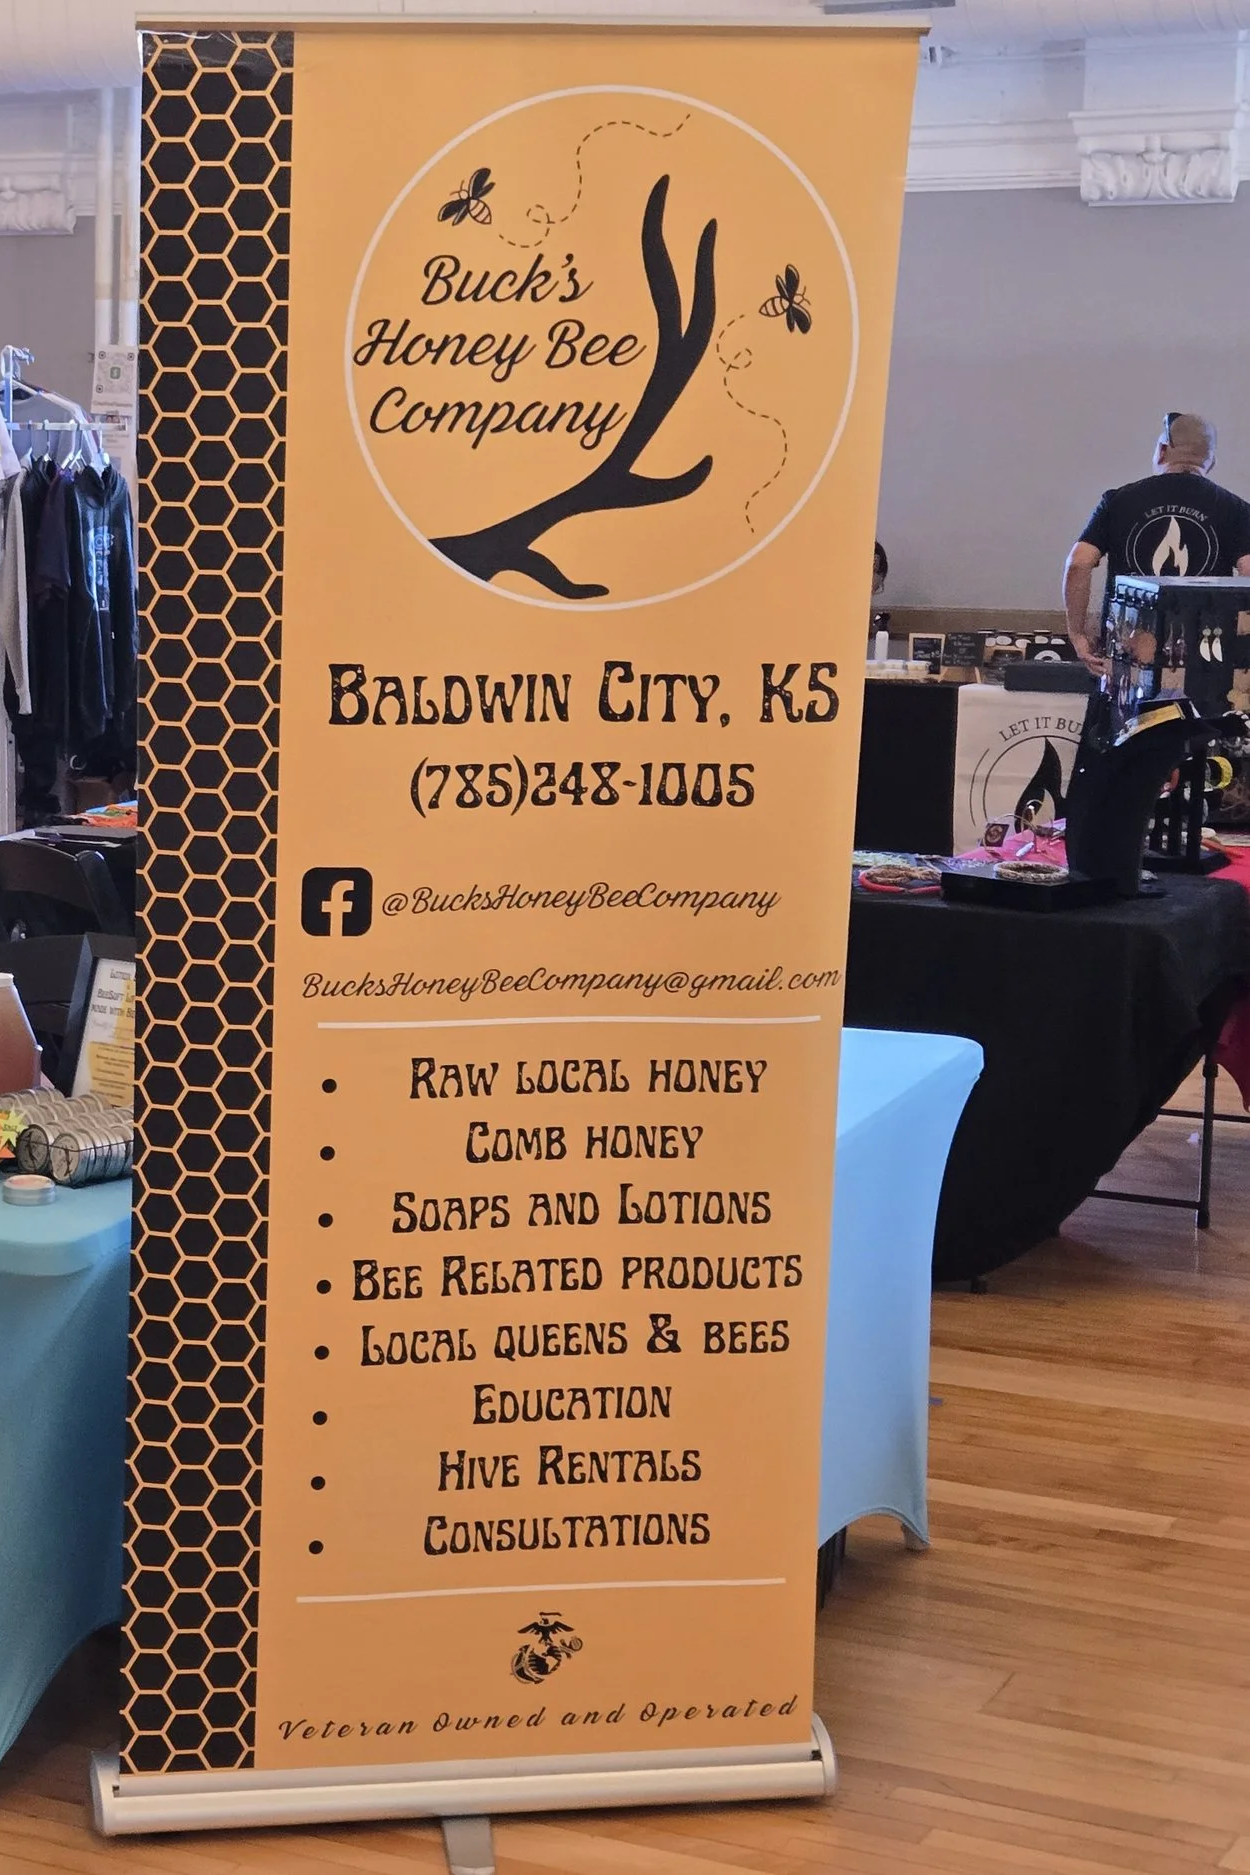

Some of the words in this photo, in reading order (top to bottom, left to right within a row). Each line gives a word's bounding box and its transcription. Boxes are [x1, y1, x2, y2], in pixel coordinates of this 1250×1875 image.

[421, 253, 594, 305] Buck's
[353, 319, 537, 383] Honey
[545, 319, 647, 369] Bee
[370, 386, 628, 450] Company
[1144, 506, 1164, 519] LET
[1179, 506, 1209, 522] BURN
[329, 664, 571, 725] BALDWIN
[759, 662, 839, 723] KS
[999, 719, 1030, 742] LET
[1035, 716, 1051, 729] IT
[411, 755, 754, 818] (785)248-1005
[382, 882, 782, 918] @BucksHoneyBeeCompany
[303, 966, 841, 1003] BucksHoneyBeeCompany@gmail.com
[647, 1313, 681, 1353] &
[279, 1718, 417, 1741] Veteran
[433, 1707, 546, 1733] Owned
[561, 1703, 625, 1726] and
[640, 1695, 798, 1728] Operated
